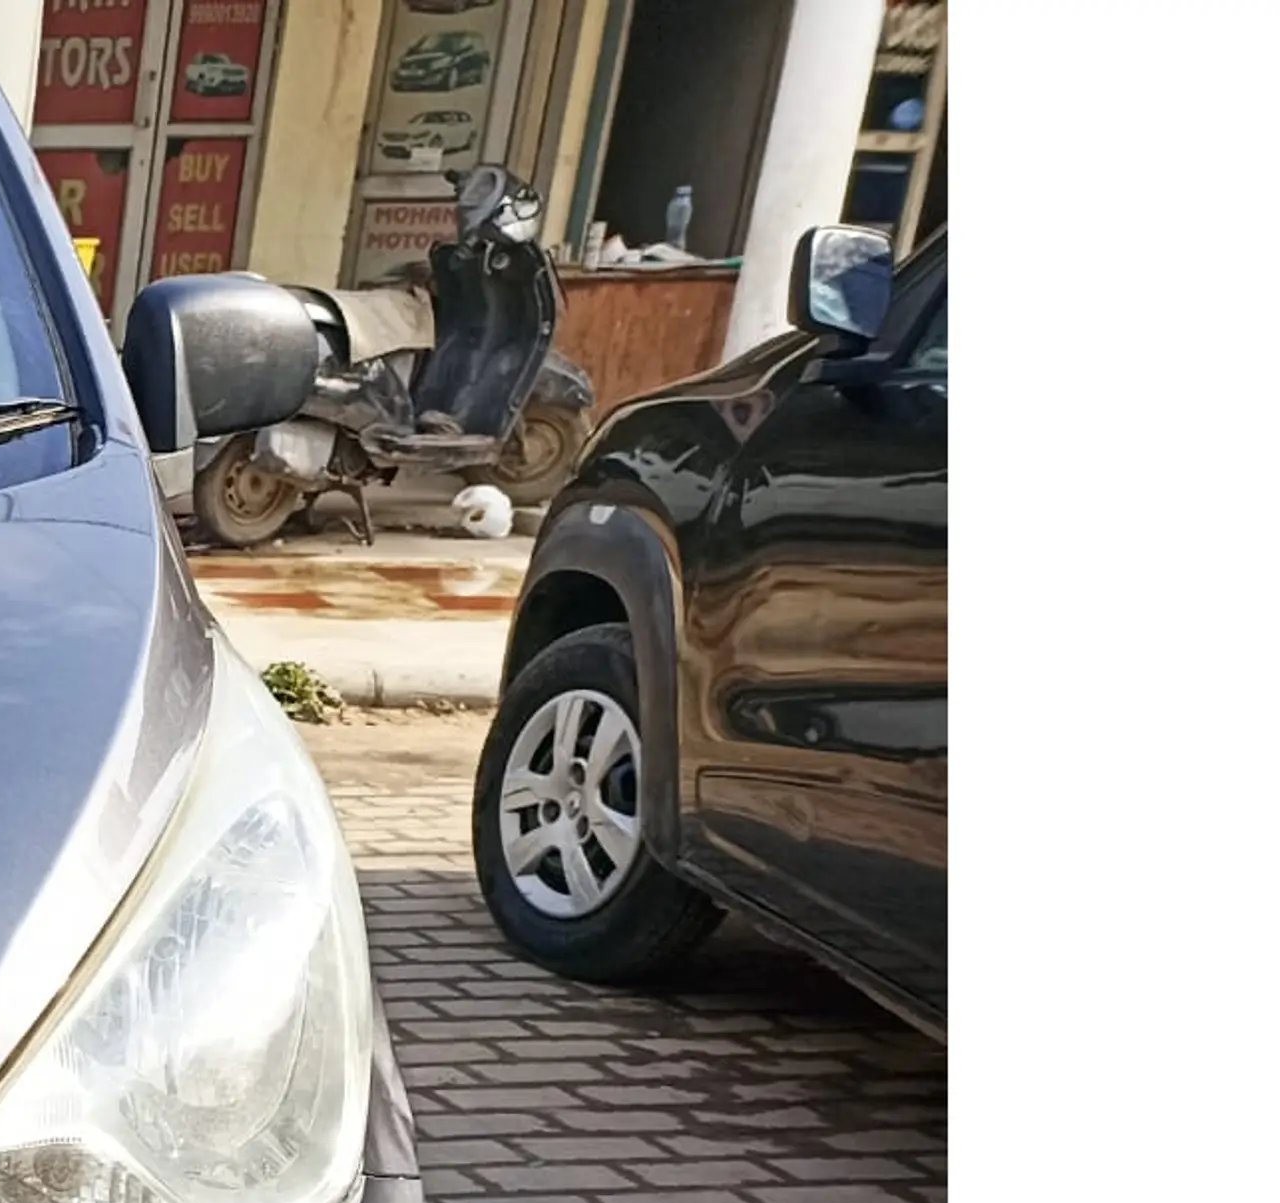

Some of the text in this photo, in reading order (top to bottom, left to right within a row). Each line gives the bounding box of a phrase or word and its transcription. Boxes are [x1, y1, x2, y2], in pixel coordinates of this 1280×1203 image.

[178, 152, 230, 182] BUY
[167, 203, 226, 233] SELL
[374, 206, 458, 226] MOHAN
